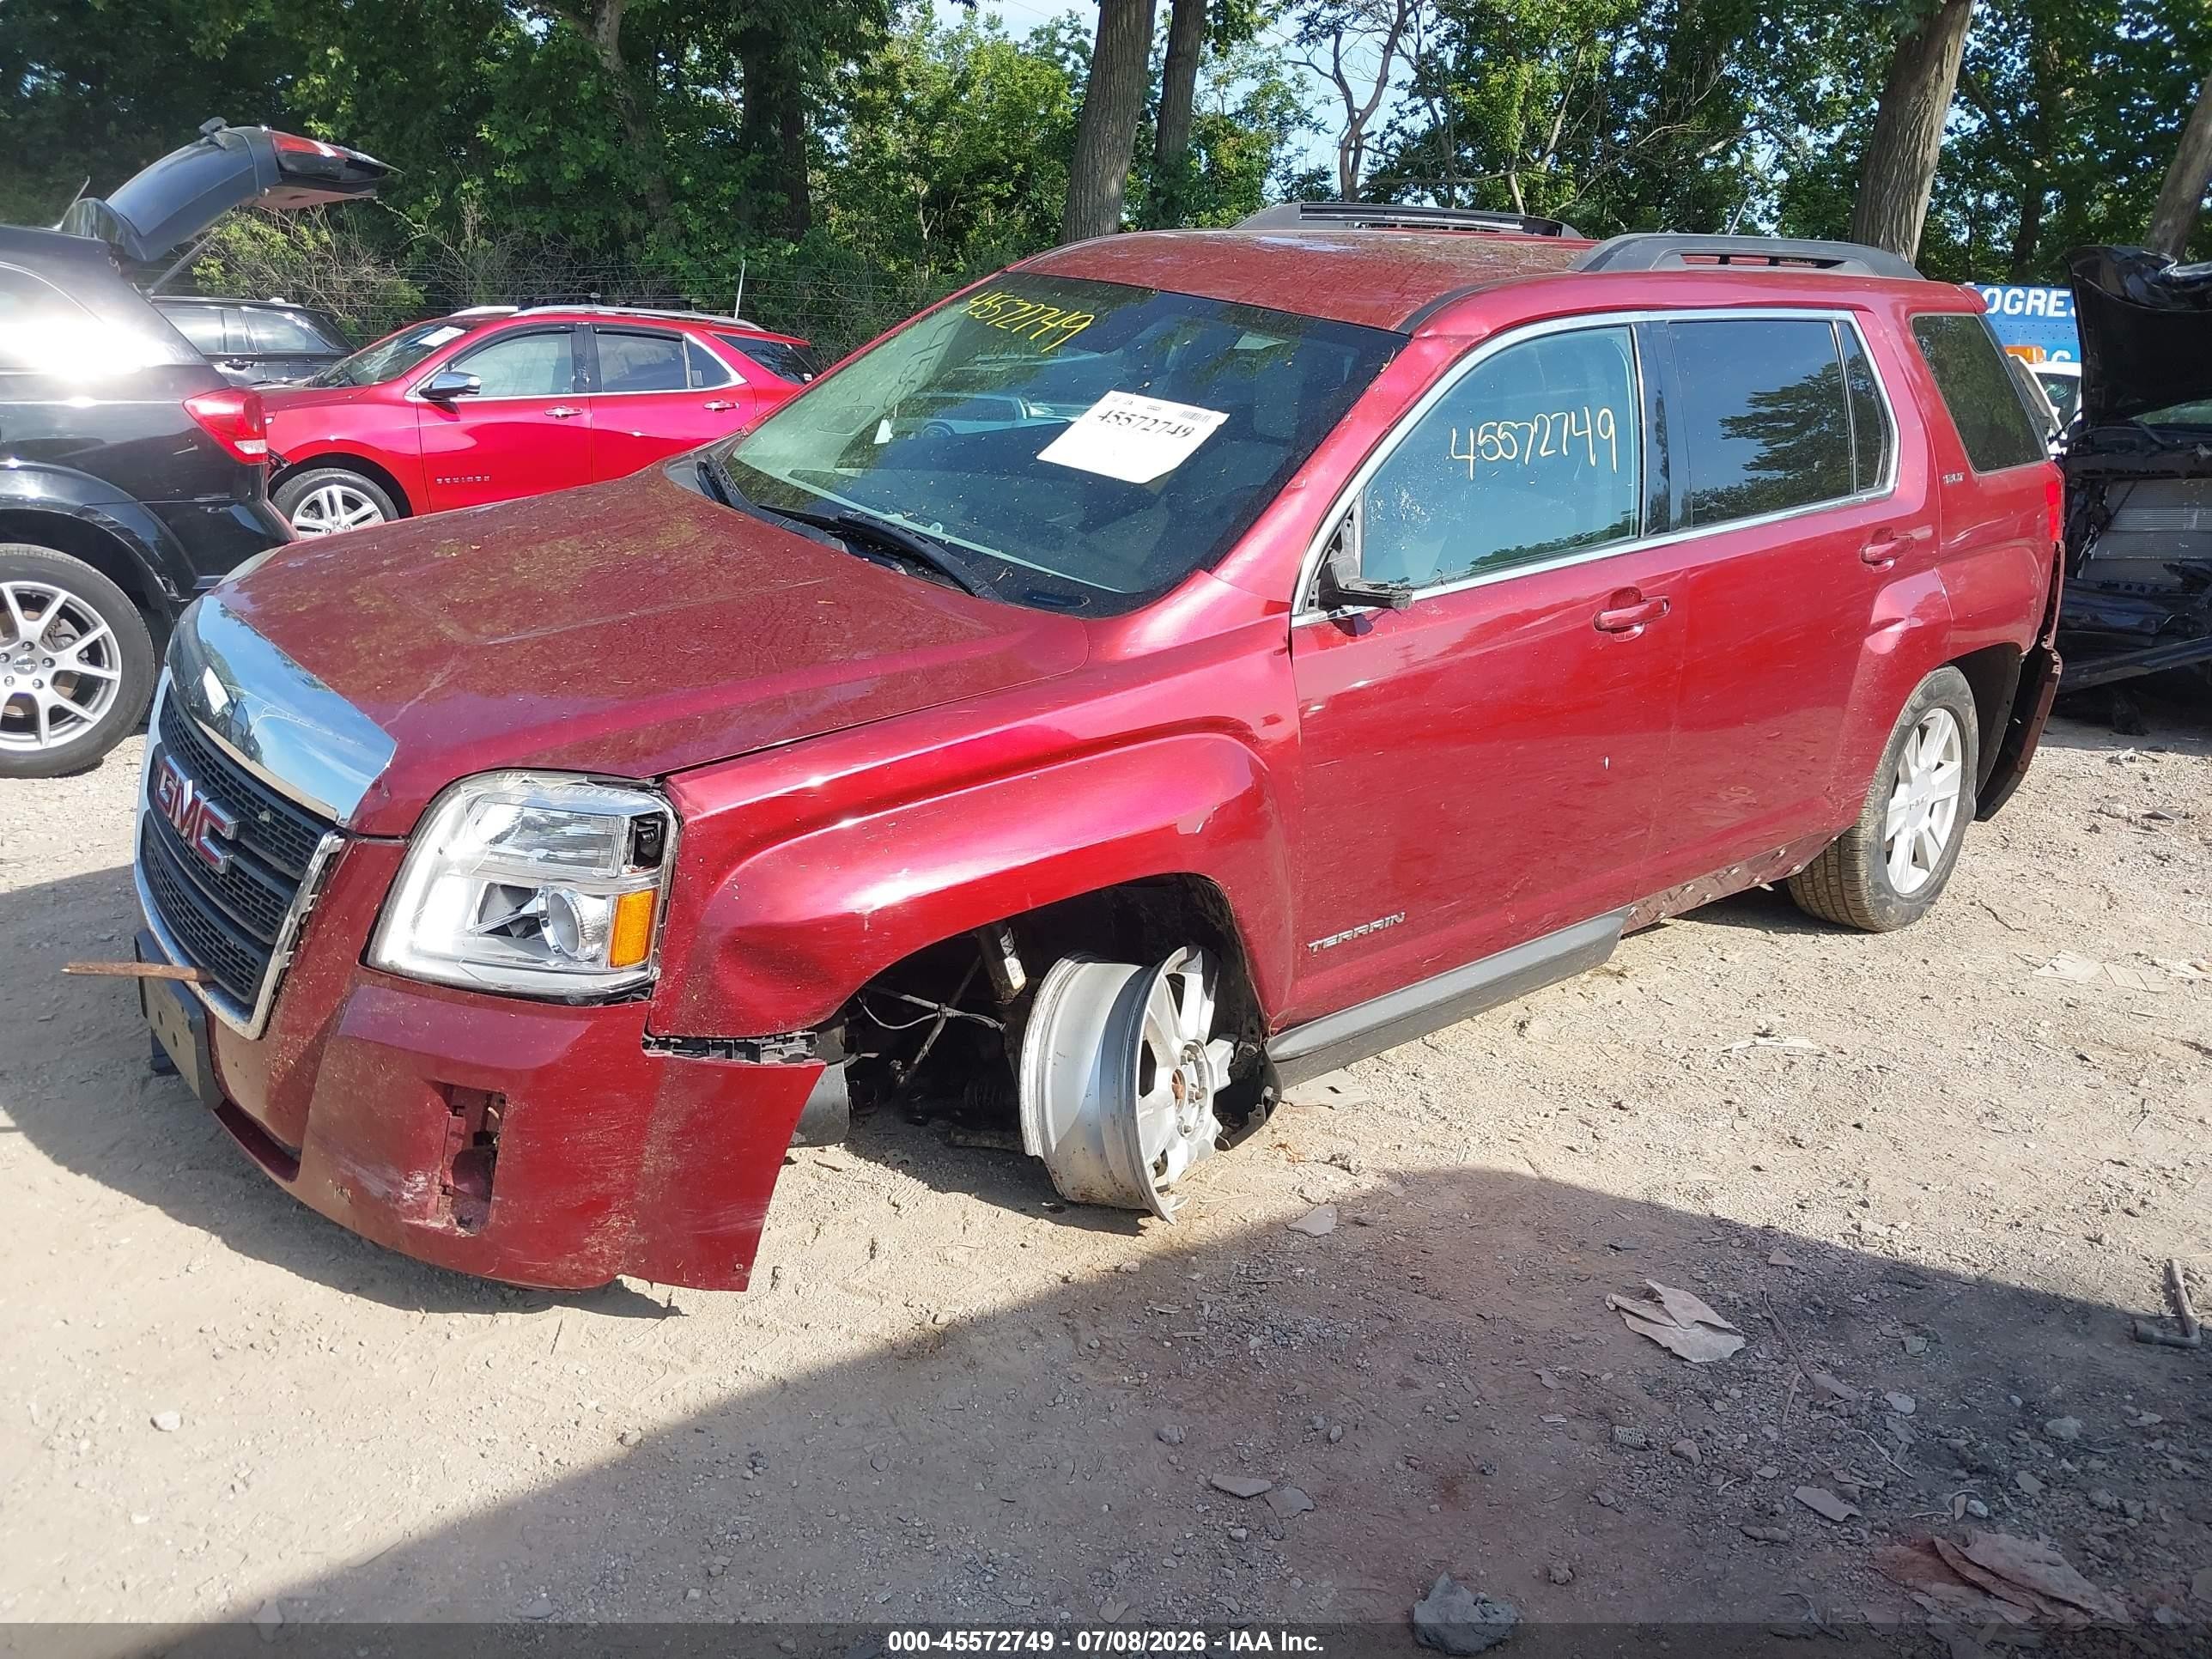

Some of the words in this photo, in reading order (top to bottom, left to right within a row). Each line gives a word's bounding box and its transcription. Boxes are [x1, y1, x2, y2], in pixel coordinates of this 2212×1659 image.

[960, 292, 1095, 353] 45572749
[1982, 288, 2076, 318] OGRE
[1097, 409, 1195, 439] 45572749
[1450, 406, 1618, 481] 45572749
[155, 755, 240, 874] GMC
[1307, 911, 1406, 954] TERRAIN
